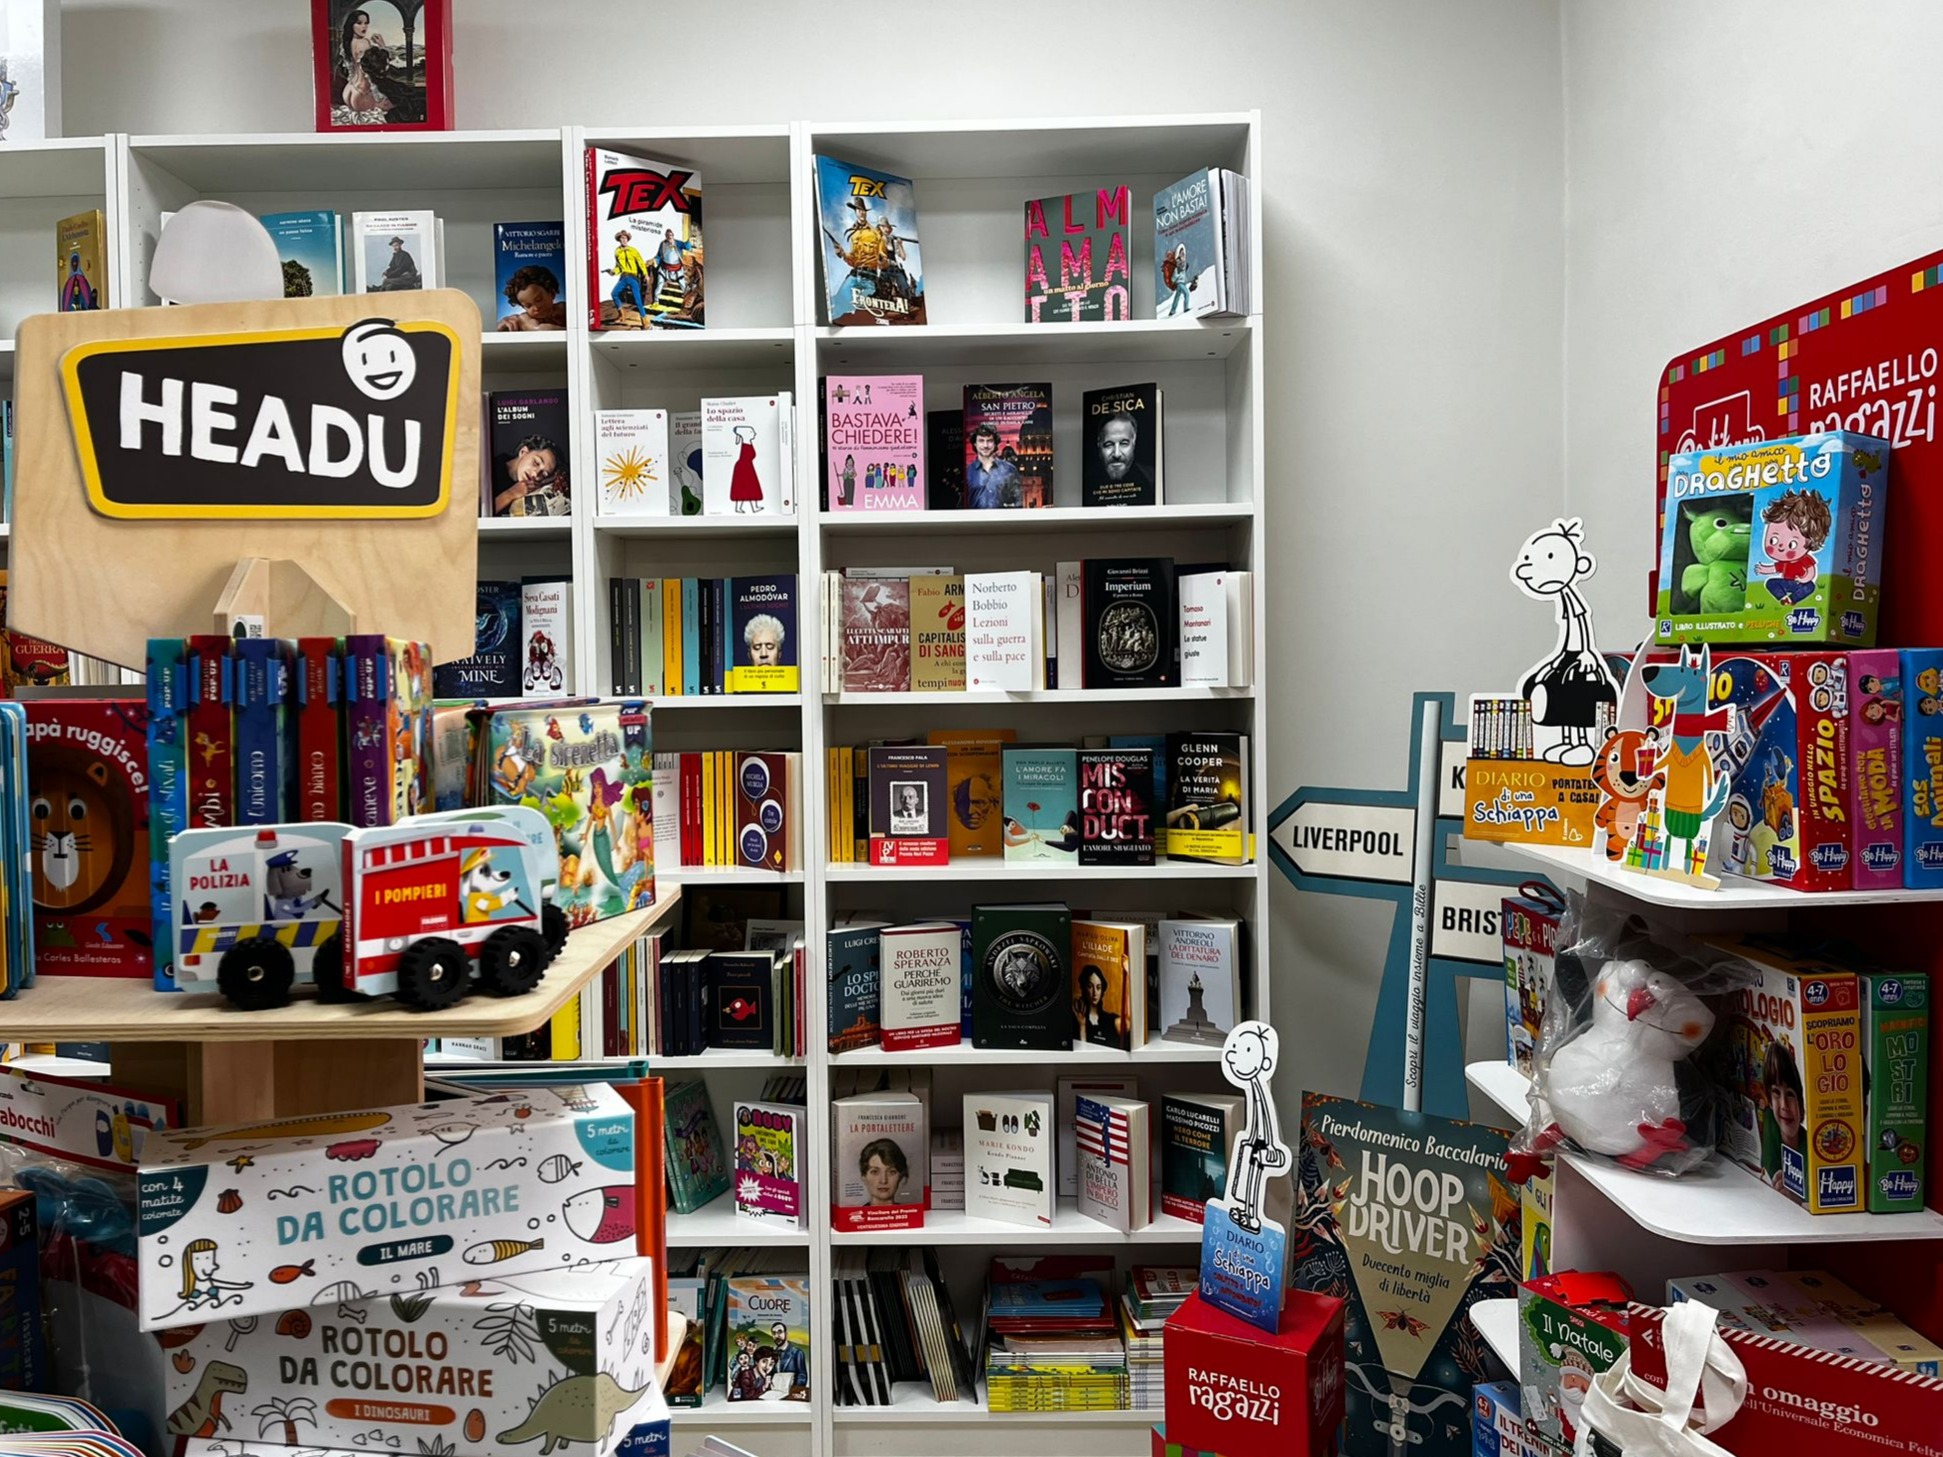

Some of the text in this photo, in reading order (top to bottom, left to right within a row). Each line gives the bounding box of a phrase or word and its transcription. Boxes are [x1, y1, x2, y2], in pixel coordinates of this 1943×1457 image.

[598, 168, 694, 221] TEX
[848, 175, 887, 200] TEX
[1171, 179, 1207, 208] L'AMORE
[1156, 209, 1179, 231] NON
[1180, 194, 1208, 218] BASTA!
[637, 218, 663, 229] piramide
[1809, 347, 1938, 410] RAFFAELLO
[972, 390, 1045, 400] ALBERTO ANGELA
[718, 407, 743, 416] spazio
[981, 401, 1035, 411] SAN PIETRO
[1091, 398, 1145, 415] DE SICA
[832, 412, 903, 429] BASTAVA
[119, 371, 421, 488] HEADU
[832, 429, 917, 445] CHIEDERE!
[864, 495, 919, 509] EMMA
[750, 585, 777, 593] PEDRO
[972, 582, 1017, 594] Norberto
[1105, 581, 1152, 592] Imperium
[740, 592, 788, 602] ALMODÓVAR
[972, 599, 1008, 611] Bobbio
[1183, 604, 1204, 614] Tomaso
[972, 616, 1008, 628] Lezioni
[1184, 619, 1211, 628] Montanari
[918, 633, 966, 644] CAPITALIS
[972, 633, 1026, 648] sulla guerra
[15, 645, 65, 655] GUERRA
[918, 645, 965, 658] DI SANG
[973, 650, 1026, 665] e sulla pace
[1184, 650, 1200, 660] giuste
[209, 659, 218, 701] POP-UP
[458, 670, 505, 684] MINE
[26, 717, 149, 794] apà ruggisce!
[1181, 743, 1218, 754] GLENN
[1115, 755, 1148, 763] DOUGLAS
[1177, 756, 1223, 767] COOPER
[1015, 766, 1054, 774] L'AMORE
[1817, 718, 1846, 823] SPAZIO
[1180, 773, 1220, 784] LA VERITÀ
[1475, 770, 1547, 789] DIARIO
[1182, 785, 1219, 794] DI MARIA
[1499, 788, 1535, 802] di una
[1472, 799, 1560, 832] Schiappa
[1292, 825, 1404, 857] LIVERPOOL
[209, 858, 229, 873] LA
[189, 872, 250, 891] POLIZIA
[374, 882, 448, 905] I POMPIERI
[1172, 929, 1215, 940] VITTORINO
[1174, 937, 1214, 947] ANDREOLI
[844, 938, 863, 949] LUIGI
[1082, 941, 1113, 954] L'ILIADE
[1178, 944, 1222, 956] DITTATURA
[43, 952, 122, 965] Carles Ballesteros
[896, 947, 949, 960] ROBERTO
[1170, 951, 1219, 963] DEL DENARO
[893, 957, 951, 970] SPERANZA
[903, 967, 942, 980] PERCHÉ
[893, 976, 952, 990] GUARIREMO
[1405, 883, 1427, 1089] Scopri il viaggio insieme a Billie
[1806, 980, 1824, 996] 4-7
[1881, 979, 1898, 996] 4-7
[1805, 1016, 1855, 1030] SCOPRIAMO
[1820, 1053, 1847, 1073] LO
[1815, 1073, 1849, 1095] GIO
[0, 1107, 56, 1139] abocchi
[750, 1108, 794, 1134] ROBY
[1166, 1105, 1220, 1125] CARLO LUCARELLI
[586, 1123, 630, 1138] 5 metri
[849, 1121, 915, 1133] LA PORTALETTERE
[1166, 1114, 1220, 1133] MASSIMO PICOZZI
[1173, 1126, 1212, 1141] NERO COME
[979, 1139, 1035, 1154] MARIE KONDO
[1320, 1114, 1508, 1172] Pierdomenico Baccalario
[1085, 1162, 1118, 1181] ANTONIO
[327, 1157, 473, 1205] ROTOLO
[1086, 1172, 1118, 1190] DI BELLA
[1086, 1181, 1118, 1197] L'IMPERO
[1350, 1149, 1466, 1219] HOOP
[1819, 1172, 1855, 1196] Happy
[141, 1194, 184, 1208] matite
[141, 1207, 183, 1221] colorate
[276, 1184, 520, 1246] DA COLORARE
[1348, 1201, 1470, 1266] DRIVER
[1226, 1230, 1265, 1254] DIARIO
[379, 1241, 433, 1260] IL MARE
[1212, 1248, 1271, 1295] Schiappa
[1362, 1253, 1450, 1290] Duecento miglia
[1378, 1276, 1432, 1304] di libertà
[748, 1295, 792, 1314] CUORE
[547, 1319, 593, 1336] 5 metri
[321, 1325, 448, 1361] ROTOLO
[279, 1355, 494, 1398] DA COLORARE
[1188, 1367, 1281, 1399] RAFFAELLO
[1188, 1383, 1280, 1426] ragazzi
[1762, 1384, 1880, 1428] omaggio
[1743, 1399, 1831, 1431] ell'Universale
[1832, 1421, 1905, 1451] Economica
